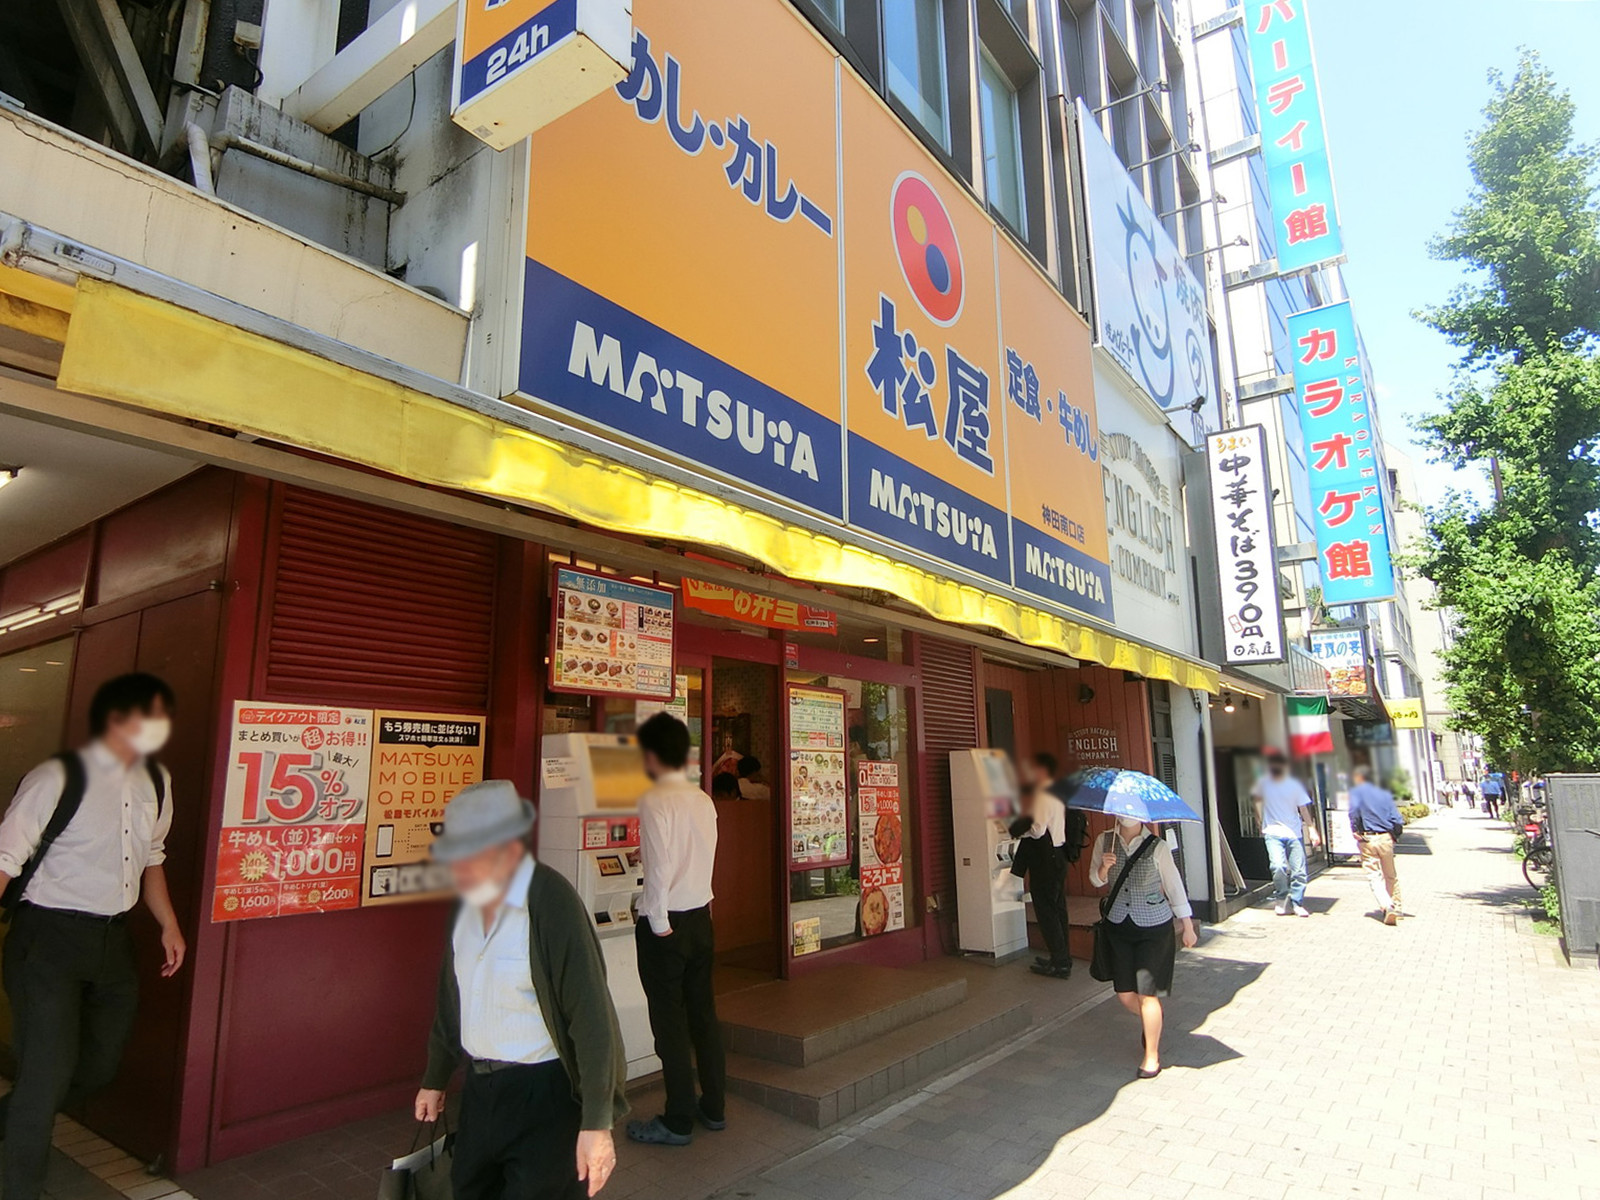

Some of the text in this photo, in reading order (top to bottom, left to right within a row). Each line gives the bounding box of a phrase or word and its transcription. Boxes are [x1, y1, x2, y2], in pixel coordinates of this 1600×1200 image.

[486, 24, 549, 85] 24h
[864, 292, 995, 477] 松屋
[1005, 347, 1099, 463] 定食・牛めし
[1216, 436, 1251, 454] うまい
[1299, 327, 1373, 581] カラオケ館
[1041, 503, 1086, 545] 神田南口店
[1102, 464, 1175, 574] ENGLISH
[1219, 453, 1264, 638] 中華そば390円
[1118, 544, 1167, 600] COMPANY
[256, 710, 339, 724] テイクアウト限定
[380, 752, 475, 767] MATSUYA
[1068, 737, 1118, 754] ENGLISH
[238, 752, 316, 820] 15
[319, 797, 358, 818] オフ
[378, 790, 455, 805] ORDE
[379, 772, 474, 785] MOBILE
